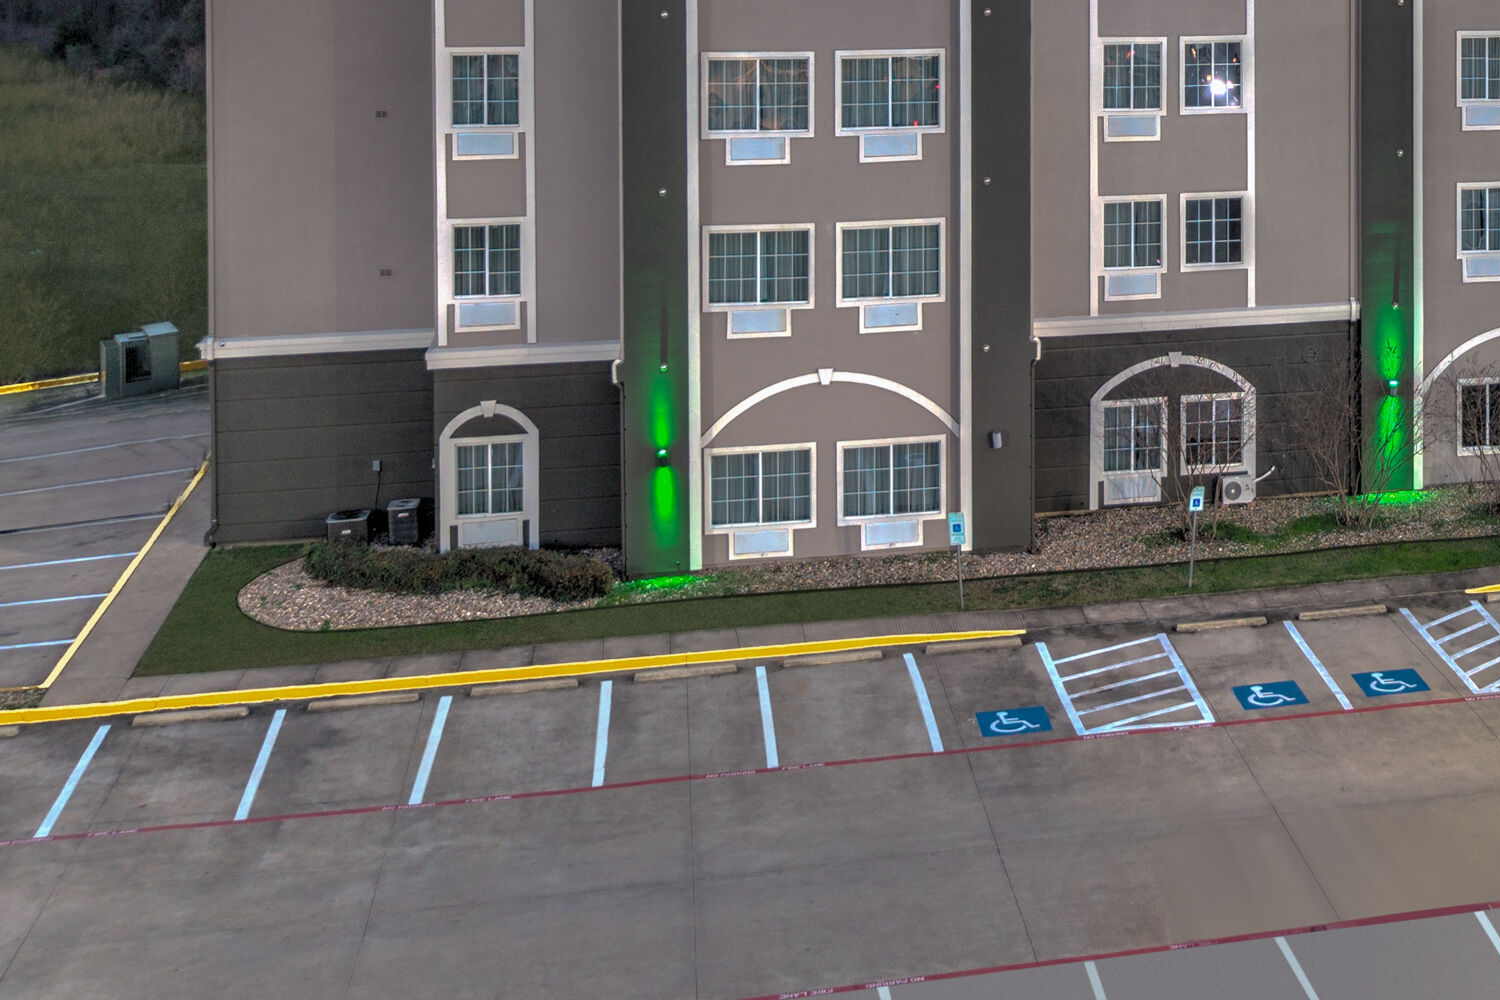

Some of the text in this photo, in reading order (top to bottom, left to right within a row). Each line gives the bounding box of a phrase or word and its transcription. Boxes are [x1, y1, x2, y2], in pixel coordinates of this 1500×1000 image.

[910, 975, 925, 983] NO
[779, 988, 833, 1000] FIRE LANE
